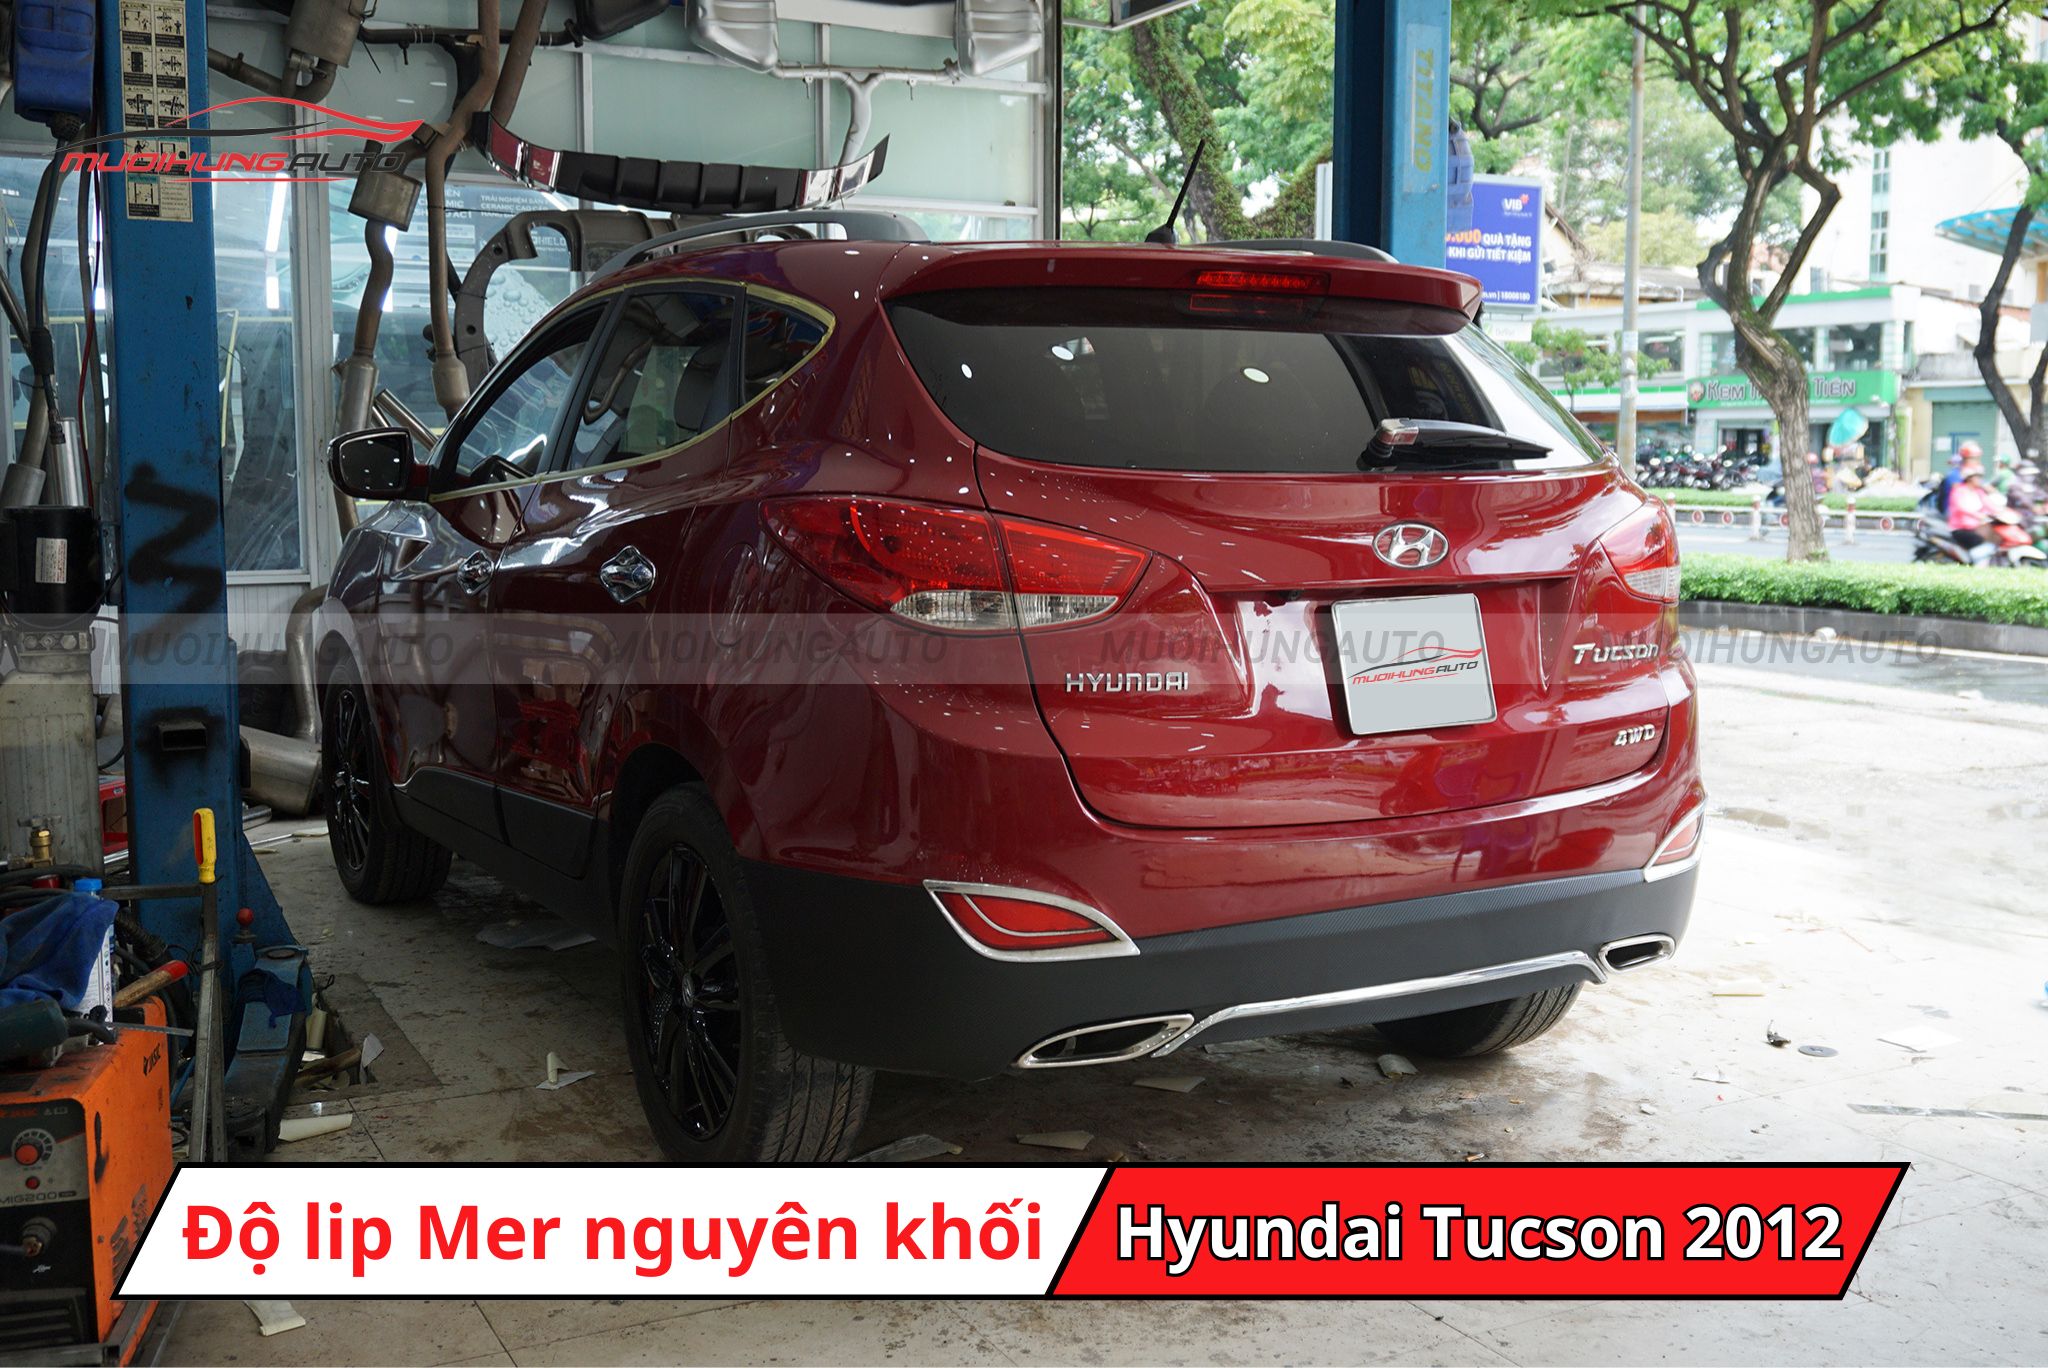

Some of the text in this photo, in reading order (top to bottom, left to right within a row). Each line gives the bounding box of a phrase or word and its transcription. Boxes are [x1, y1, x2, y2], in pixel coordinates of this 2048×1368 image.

[1503, 197, 1523, 212] VIB
[1483, 232, 1504, 247] QUÀ
[1505, 233, 1532, 249] TẶNG
[1448, 246, 1466, 259] KHI
[1507, 248, 1532, 265] KIỆM
[1572, 642, 1660, 665] Tucson
[1065, 671, 1190, 693] HYUNDAI
[1613, 724, 1656, 747] 4WD
